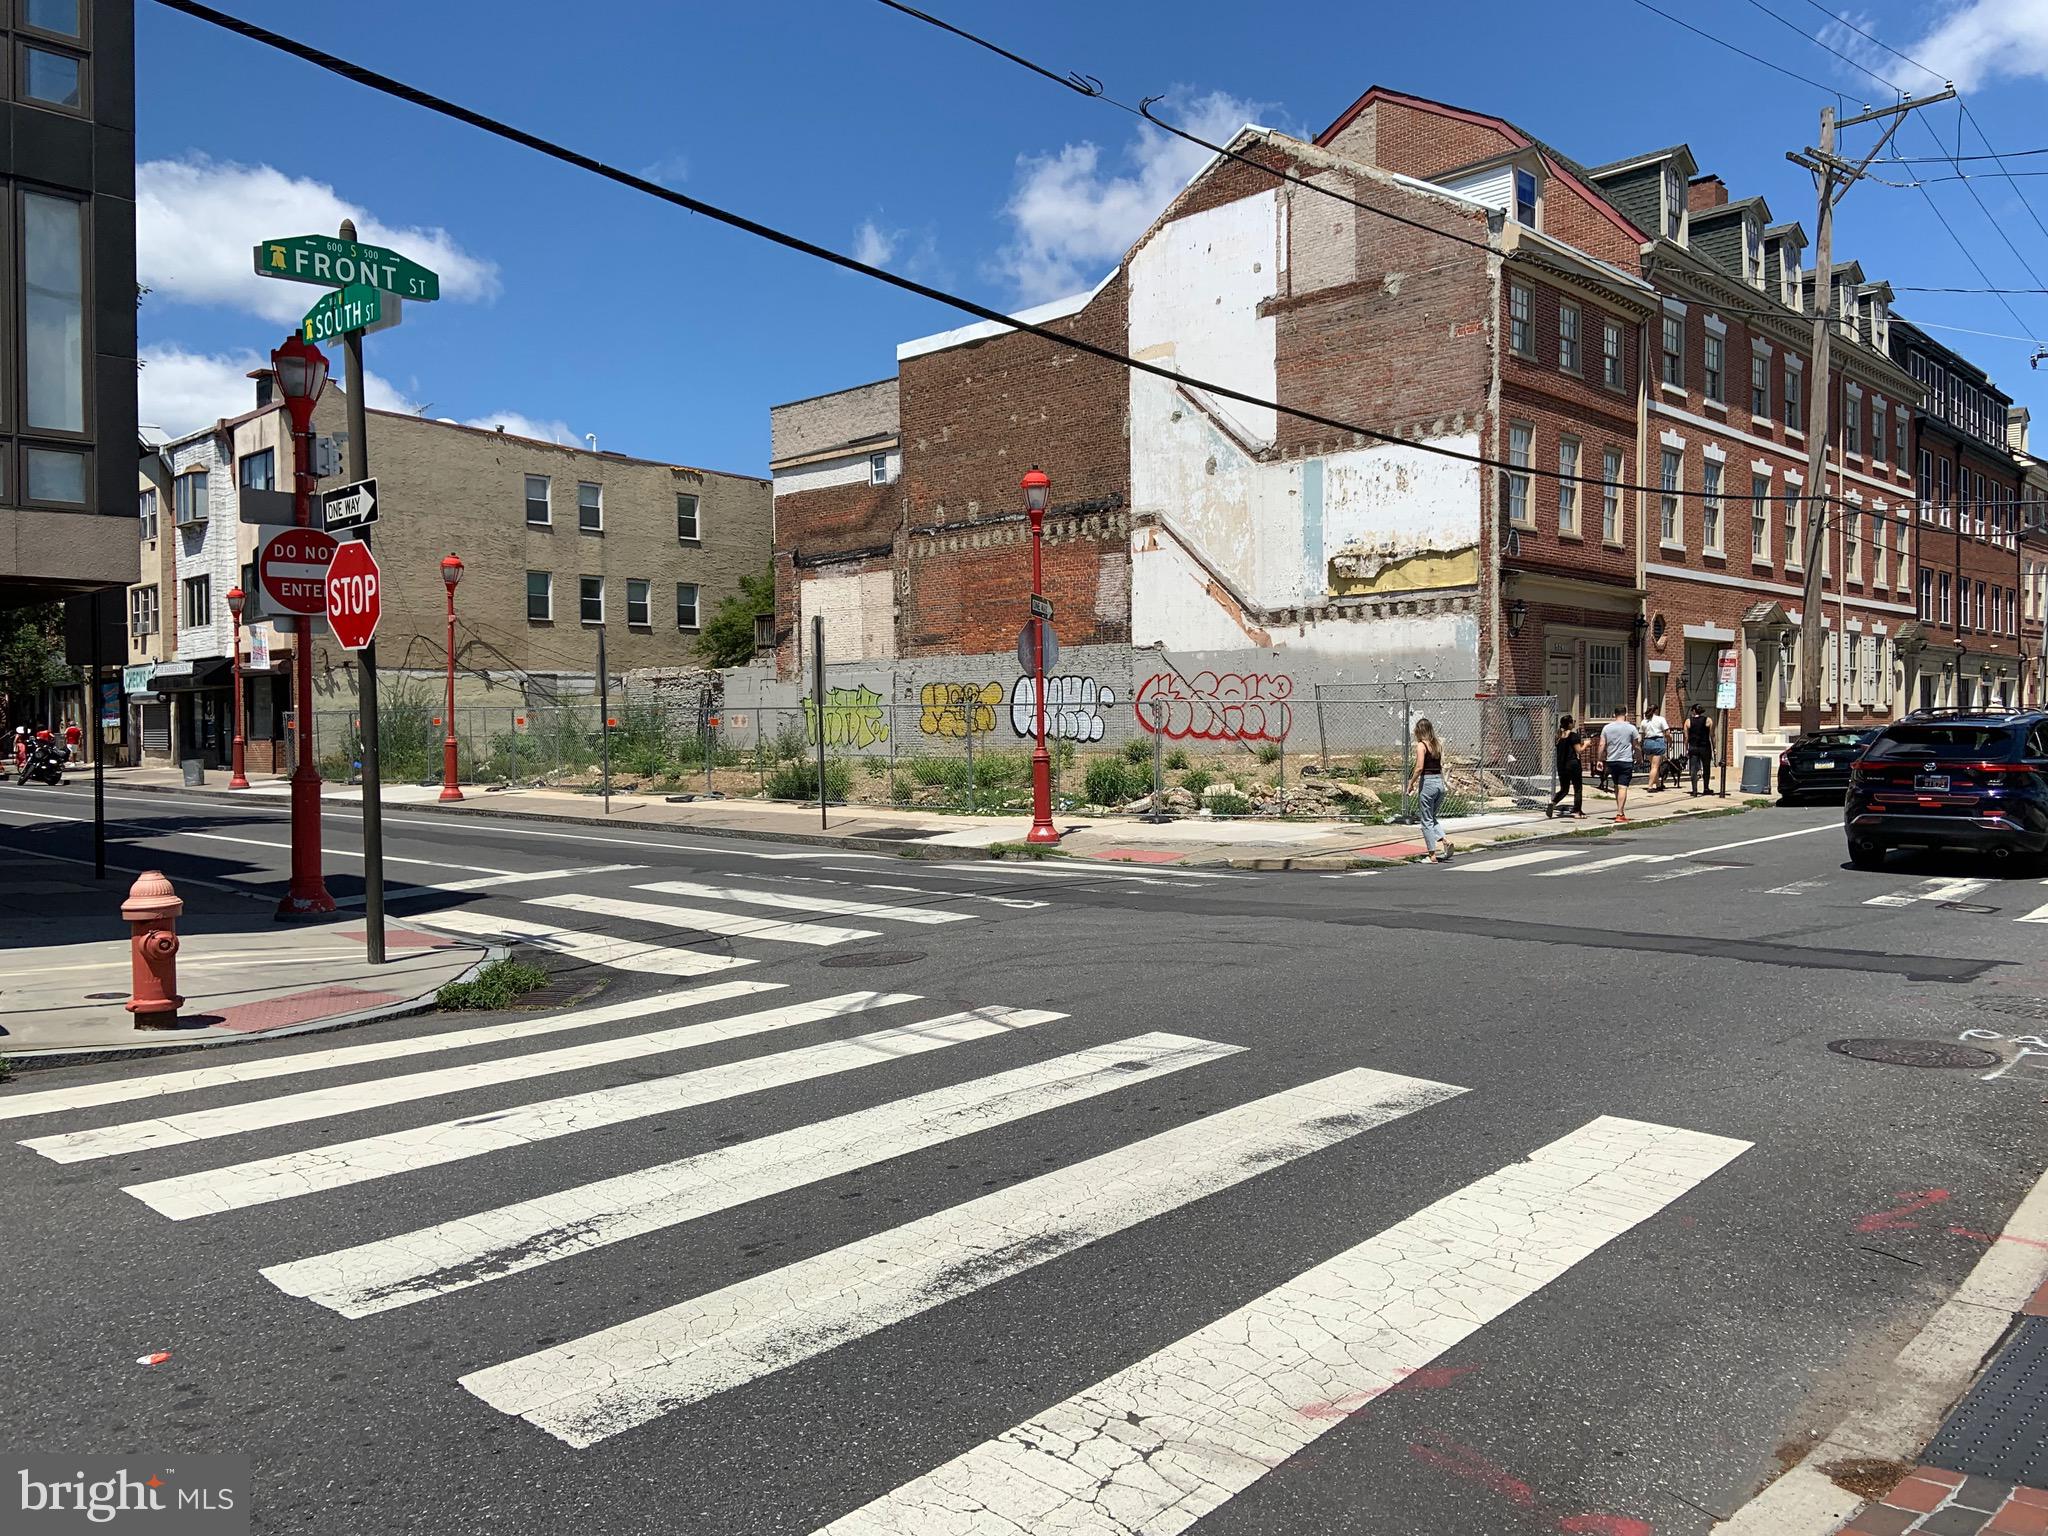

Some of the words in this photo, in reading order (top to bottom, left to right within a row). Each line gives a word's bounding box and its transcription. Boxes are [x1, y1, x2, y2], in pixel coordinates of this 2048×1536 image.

[326, 242, 343, 253] 600
[350, 244, 357, 257] S
[364, 249, 379, 260] 500
[295, 248, 397, 290] FRONT
[409, 278, 426, 296] ST
[315, 300, 361, 338] SOUTH
[365, 303, 375, 322] ST
[327, 501, 343, 519] ONE
[345, 497, 361, 515] WAY
[274, 544, 297, 558] DO
[282, 582, 327, 598] ENTE
[330, 574, 376, 617] STOP
